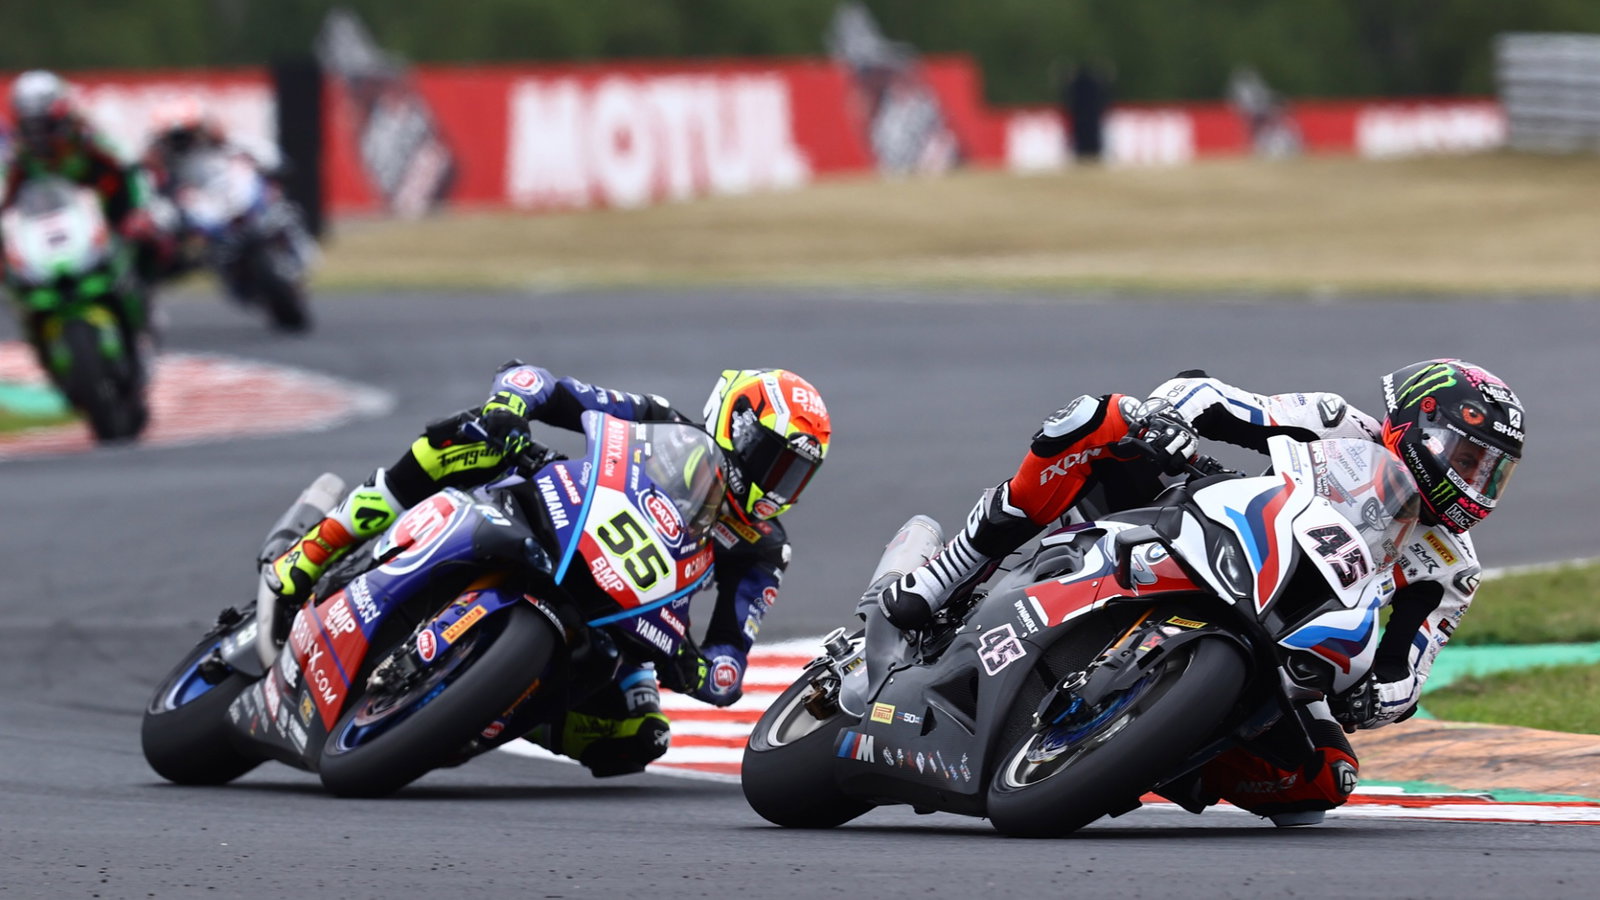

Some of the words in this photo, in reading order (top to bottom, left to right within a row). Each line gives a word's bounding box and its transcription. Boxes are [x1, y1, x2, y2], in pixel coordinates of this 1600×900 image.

[507, 74, 806, 208] MOTUL
[1449, 470, 1469, 492] ROBUS
[537, 475, 570, 530] YAMAHA
[650, 501, 678, 537] PATA
[597, 510, 670, 591] 55
[1304, 523, 1369, 590] 45
[591, 556, 625, 592] BMP
[327, 597, 357, 634] BMP
[1014, 599, 1039, 634] DYNAVOLT
[635, 616, 674, 654] YAMAHA
[977, 623, 1027, 676] 45
[855, 734, 875, 764] M
